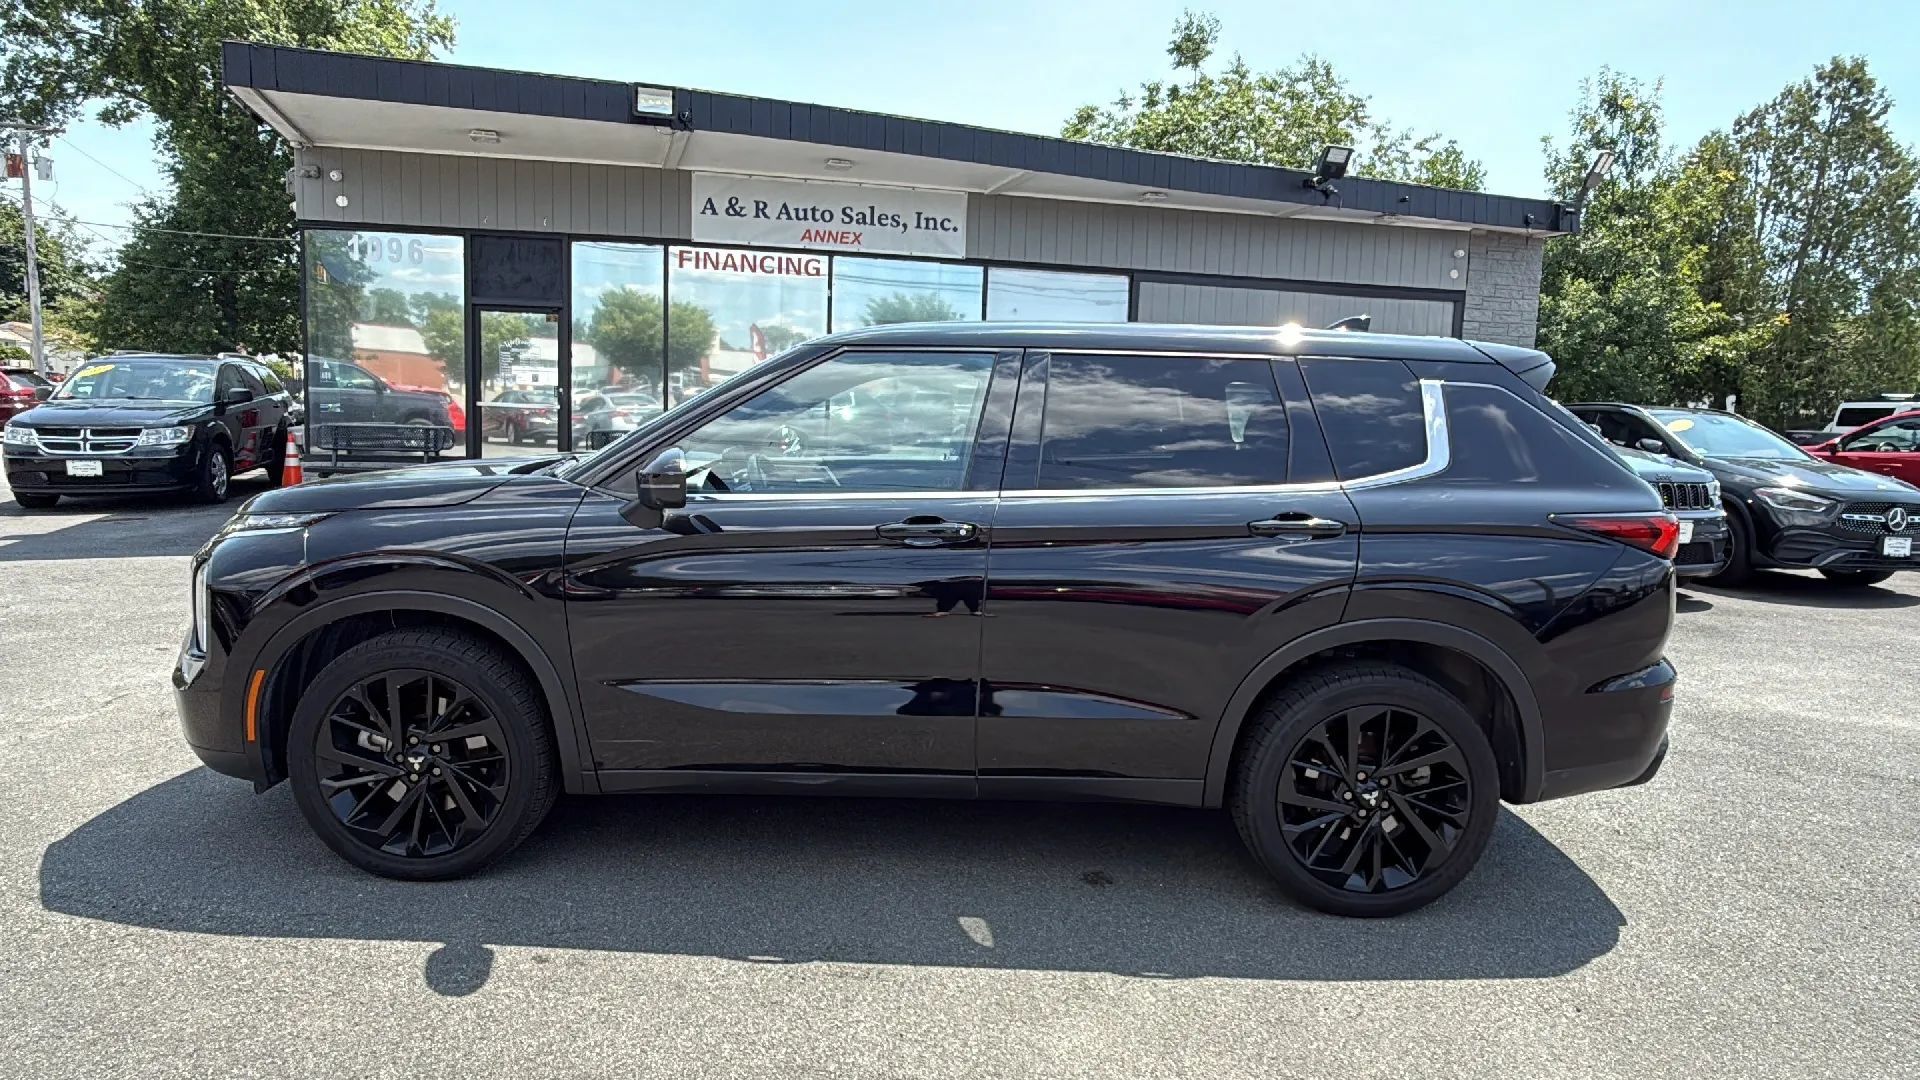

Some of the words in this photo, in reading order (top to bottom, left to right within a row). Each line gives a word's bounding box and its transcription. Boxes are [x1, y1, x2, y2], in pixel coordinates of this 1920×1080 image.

[700, 197, 718, 216] A
[725, 196, 747, 218] &
[753, 199, 771, 219] R
[776, 201, 834, 224] Auto
[840, 205, 908, 234] Sales,
[914, 211, 959, 233] Inc.
[347, 235, 424, 264] 1096
[801, 229, 863, 245] ANNEX
[678, 249, 821, 276] FINANCING
